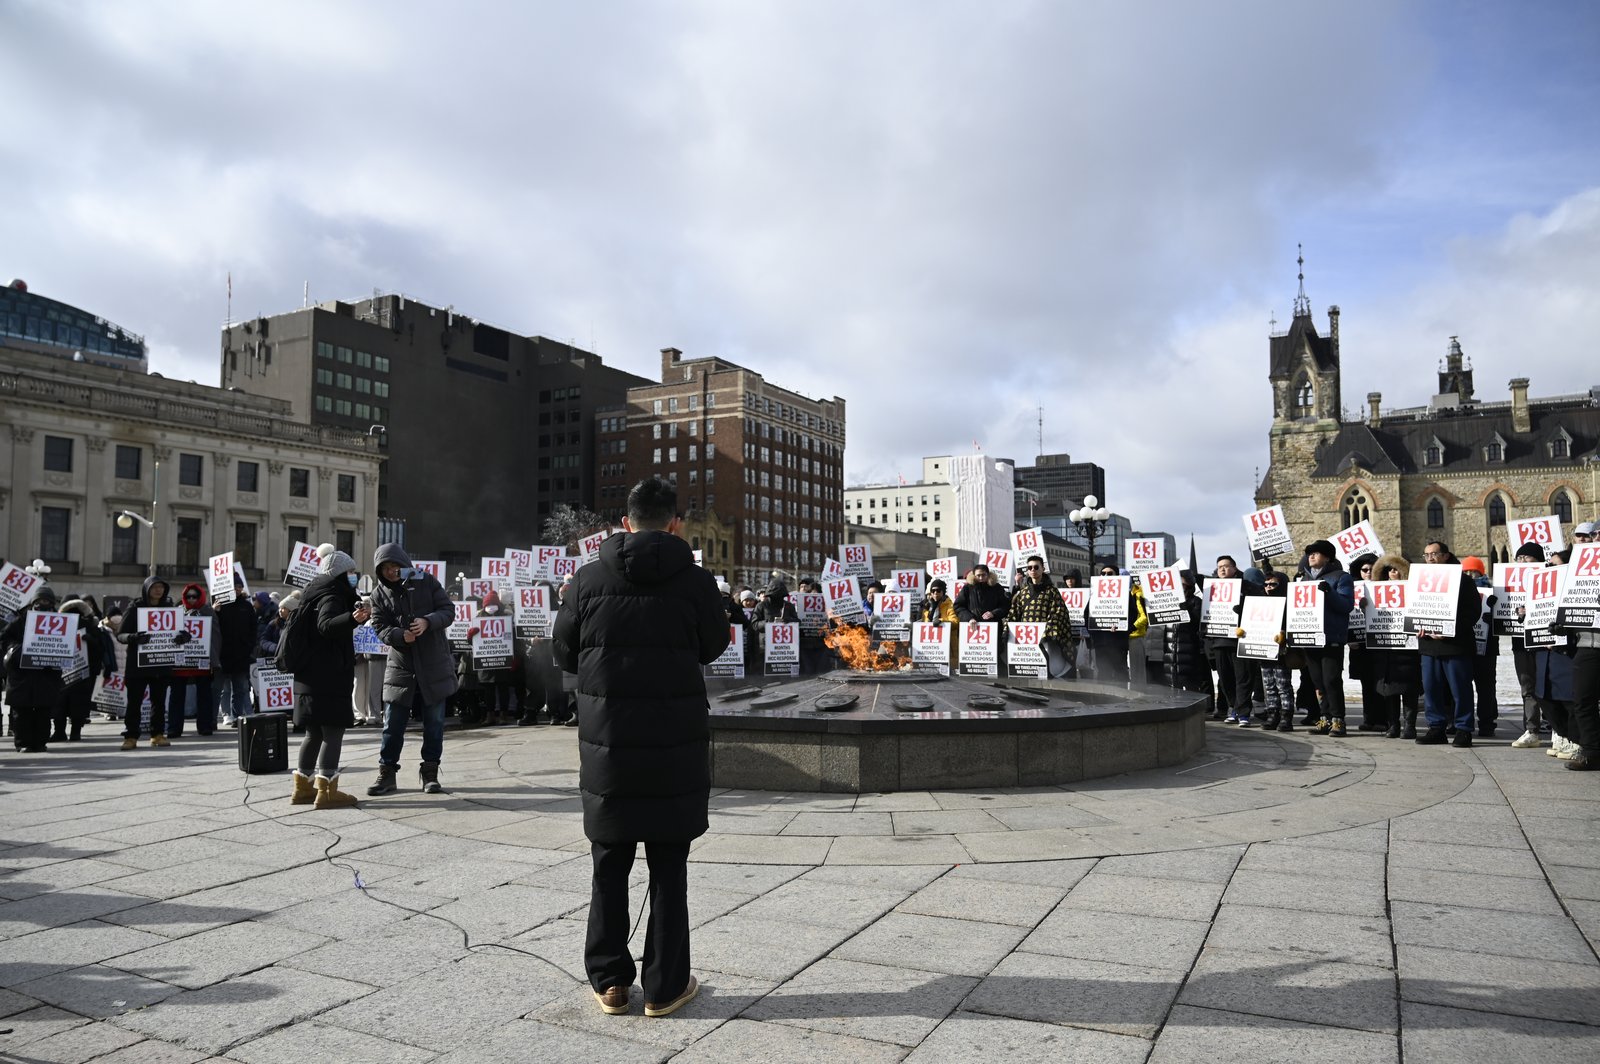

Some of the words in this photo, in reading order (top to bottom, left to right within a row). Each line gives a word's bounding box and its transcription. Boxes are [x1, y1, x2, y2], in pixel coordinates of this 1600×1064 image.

[1254, 511, 1273, 530] 19
[1019, 532, 1035, 549] 18
[1264, 536, 1286, 544] RESPONSE
[1341, 528, 1366, 553] 35
[1522, 521, 1548, 543] 28
[587, 537, 600, 552] 25
[1135, 542, 1154, 559] 43
[302, 546, 320, 566] 42
[513, 552, 528, 567] 39
[847, 547, 864, 562] 38
[988, 552, 1005, 568] 27
[1349, 548, 1369, 559] MONTHS
[1578, 548, 1600, 576] 23
[215, 558, 226, 576] 34
[492, 561, 507, 576] 15
[557, 560, 573, 575] 68
[934, 560, 949, 575] 33
[7, 570, 32, 592] 39
[473, 581, 491, 596] 53
[900, 572, 917, 588] 37
[1100, 579, 1120, 597] 33
[1150, 572, 1172, 592] 32
[1421, 571, 1448, 592] 37
[1536, 572, 1553, 599] 11
[831, 579, 850, 599] 72
[1212, 582, 1231, 602] 30
[1296, 586, 1314, 607] 31
[1378, 586, 1400, 608] 13
[523, 590, 540, 607] 31
[806, 596, 823, 612] 28
[883, 596, 901, 612] 23
[1064, 592, 1081, 608] 20
[38, 616, 64, 635] 42
[151, 611, 173, 631] 30
[483, 620, 503, 638] 40
[775, 626, 791, 643] 33
[923, 626, 940, 642] 11
[969, 626, 988, 643] 25
[1018, 626, 1037, 644] 33
[106, 675, 124, 691] 23
